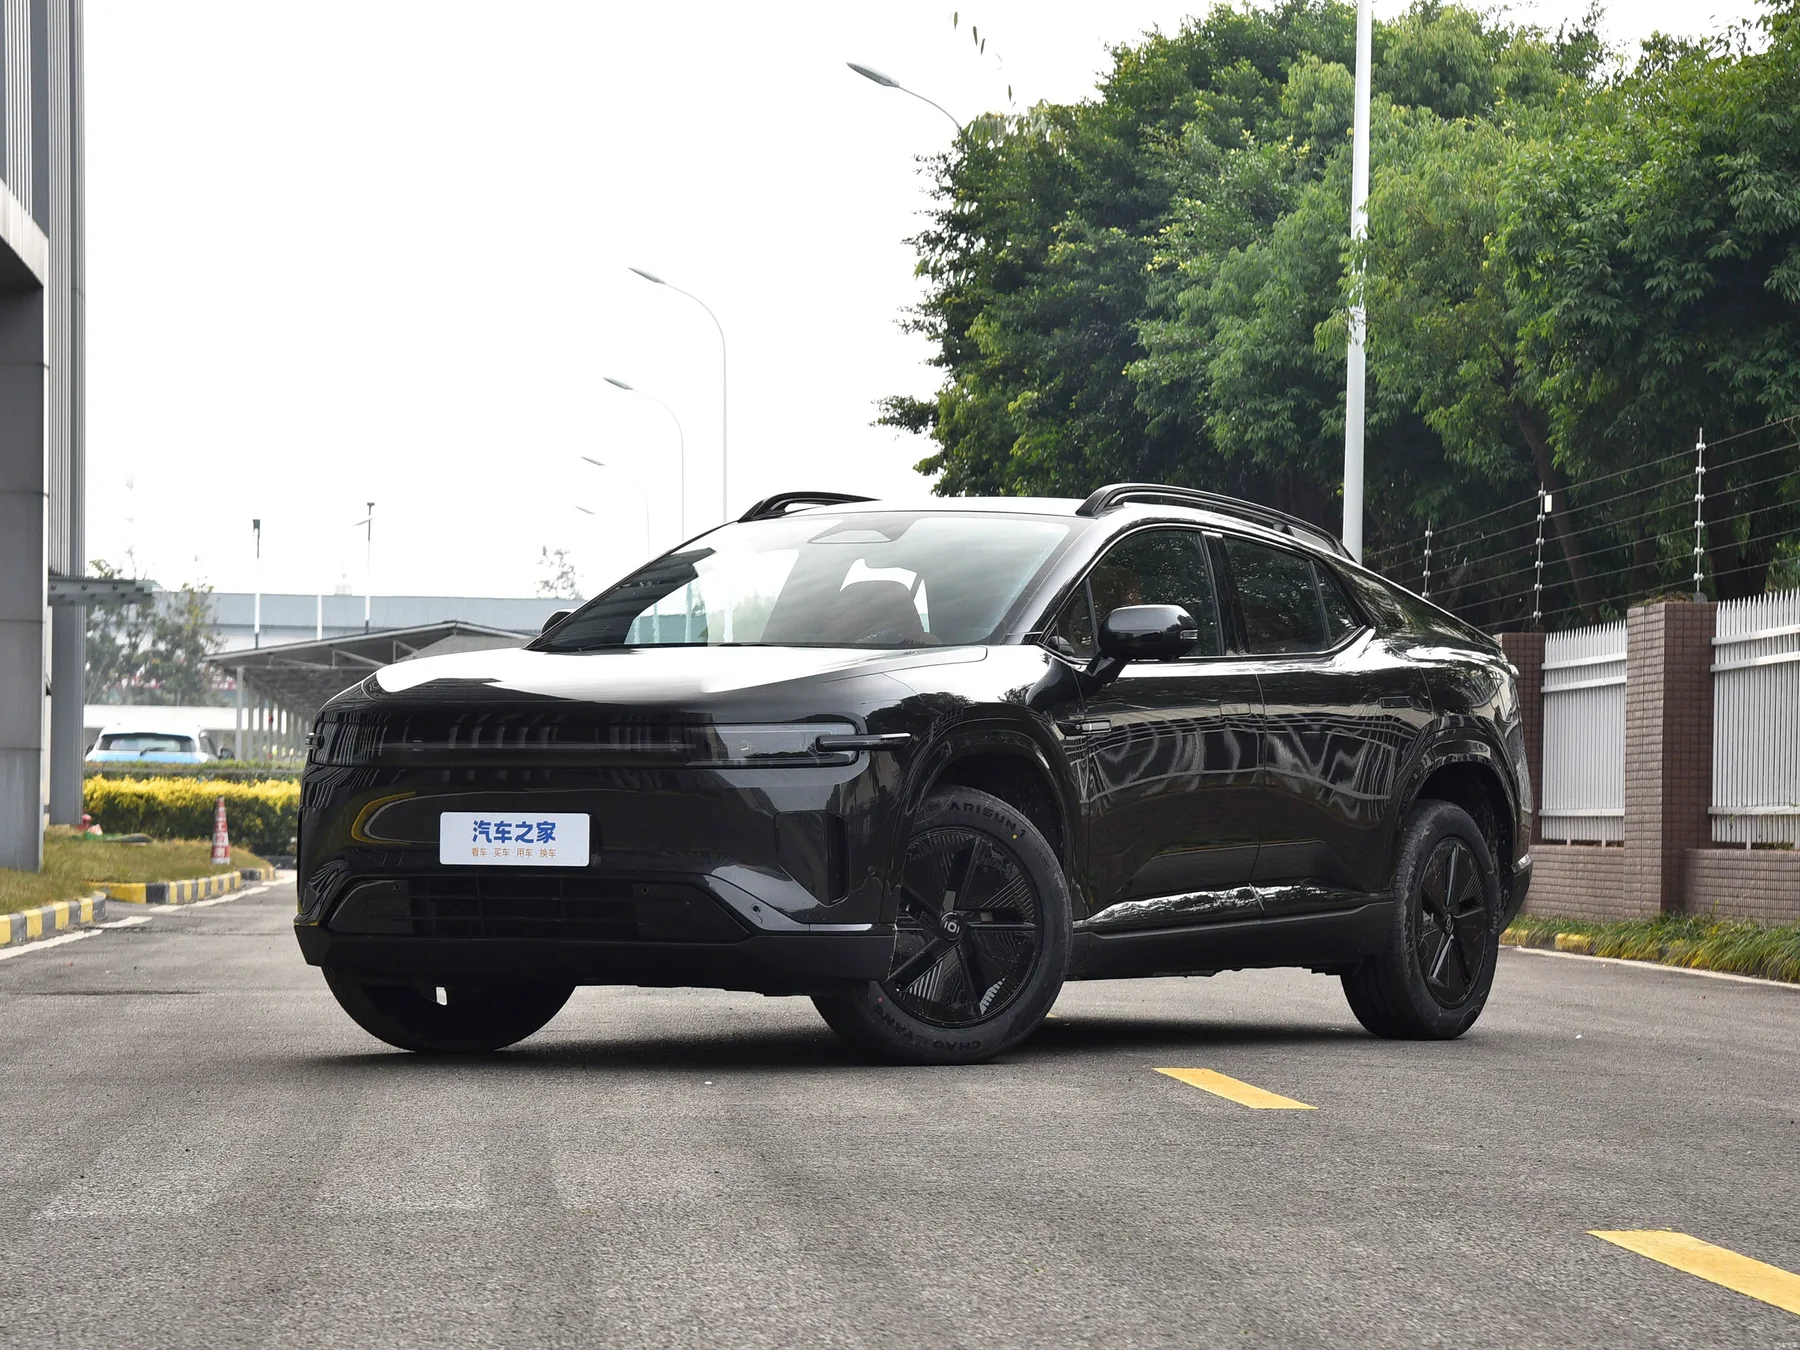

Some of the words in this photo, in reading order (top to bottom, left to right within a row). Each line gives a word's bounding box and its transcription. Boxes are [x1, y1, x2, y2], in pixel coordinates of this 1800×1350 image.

[949, 802, 1017, 831] ARISUN
[472, 820, 556, 844] 汽车之家
